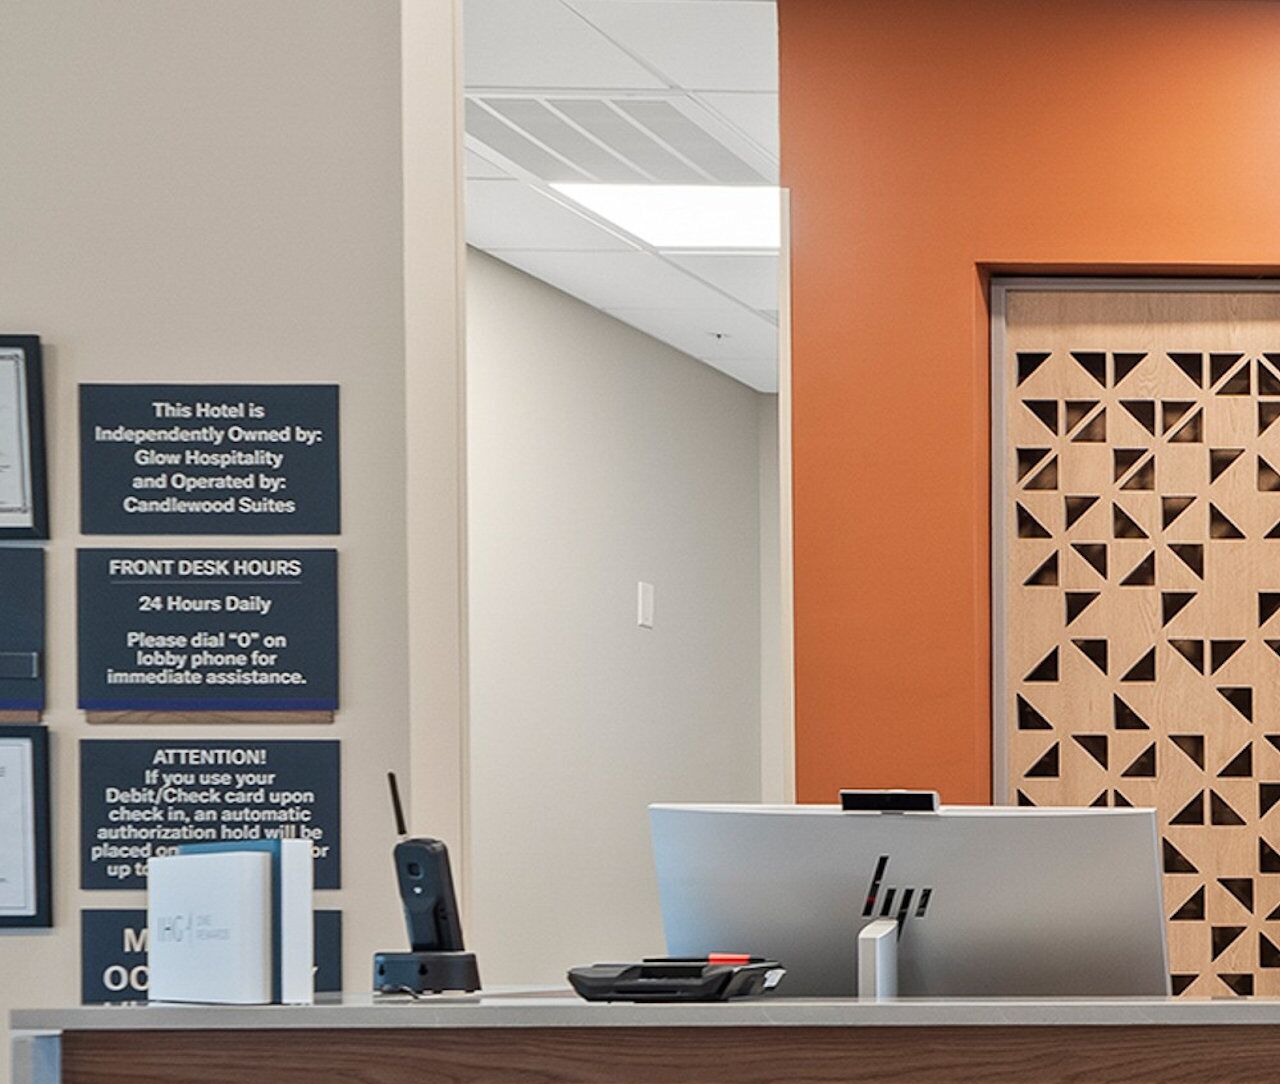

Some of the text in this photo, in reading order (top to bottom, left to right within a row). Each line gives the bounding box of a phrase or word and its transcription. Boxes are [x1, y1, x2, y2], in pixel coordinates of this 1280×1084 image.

[152, 402, 265, 418] This Hotel is
[95, 426, 322, 445] Independently Owned by:
[135, 450, 283, 468] Glow Hospitality
[133, 473, 286, 492] and Operated by:
[123, 497, 296, 513] Candlewood Suites
[110, 560, 301, 575] FRONT DESK HOURS
[139, 596, 271, 614] 24 Hours Daily
[127, 632, 187, 648] Please
[191, 632, 224, 648] dial
[263, 636, 286, 648] on
[137, 650, 277, 668] lobby phone for
[108, 668, 306, 684] immediate assistance.
[153, 749, 266, 765] ATTENTION!
[145, 769, 276, 791] If you use your
[106, 786, 315, 806] Debit/Check card upon
[109, 807, 311, 824] check in, an automatic
[97, 824, 322, 840] authorization hold will be
[91, 842, 151, 861] placed
[155, 845, 178, 857] on
[107, 865, 131, 879] up
